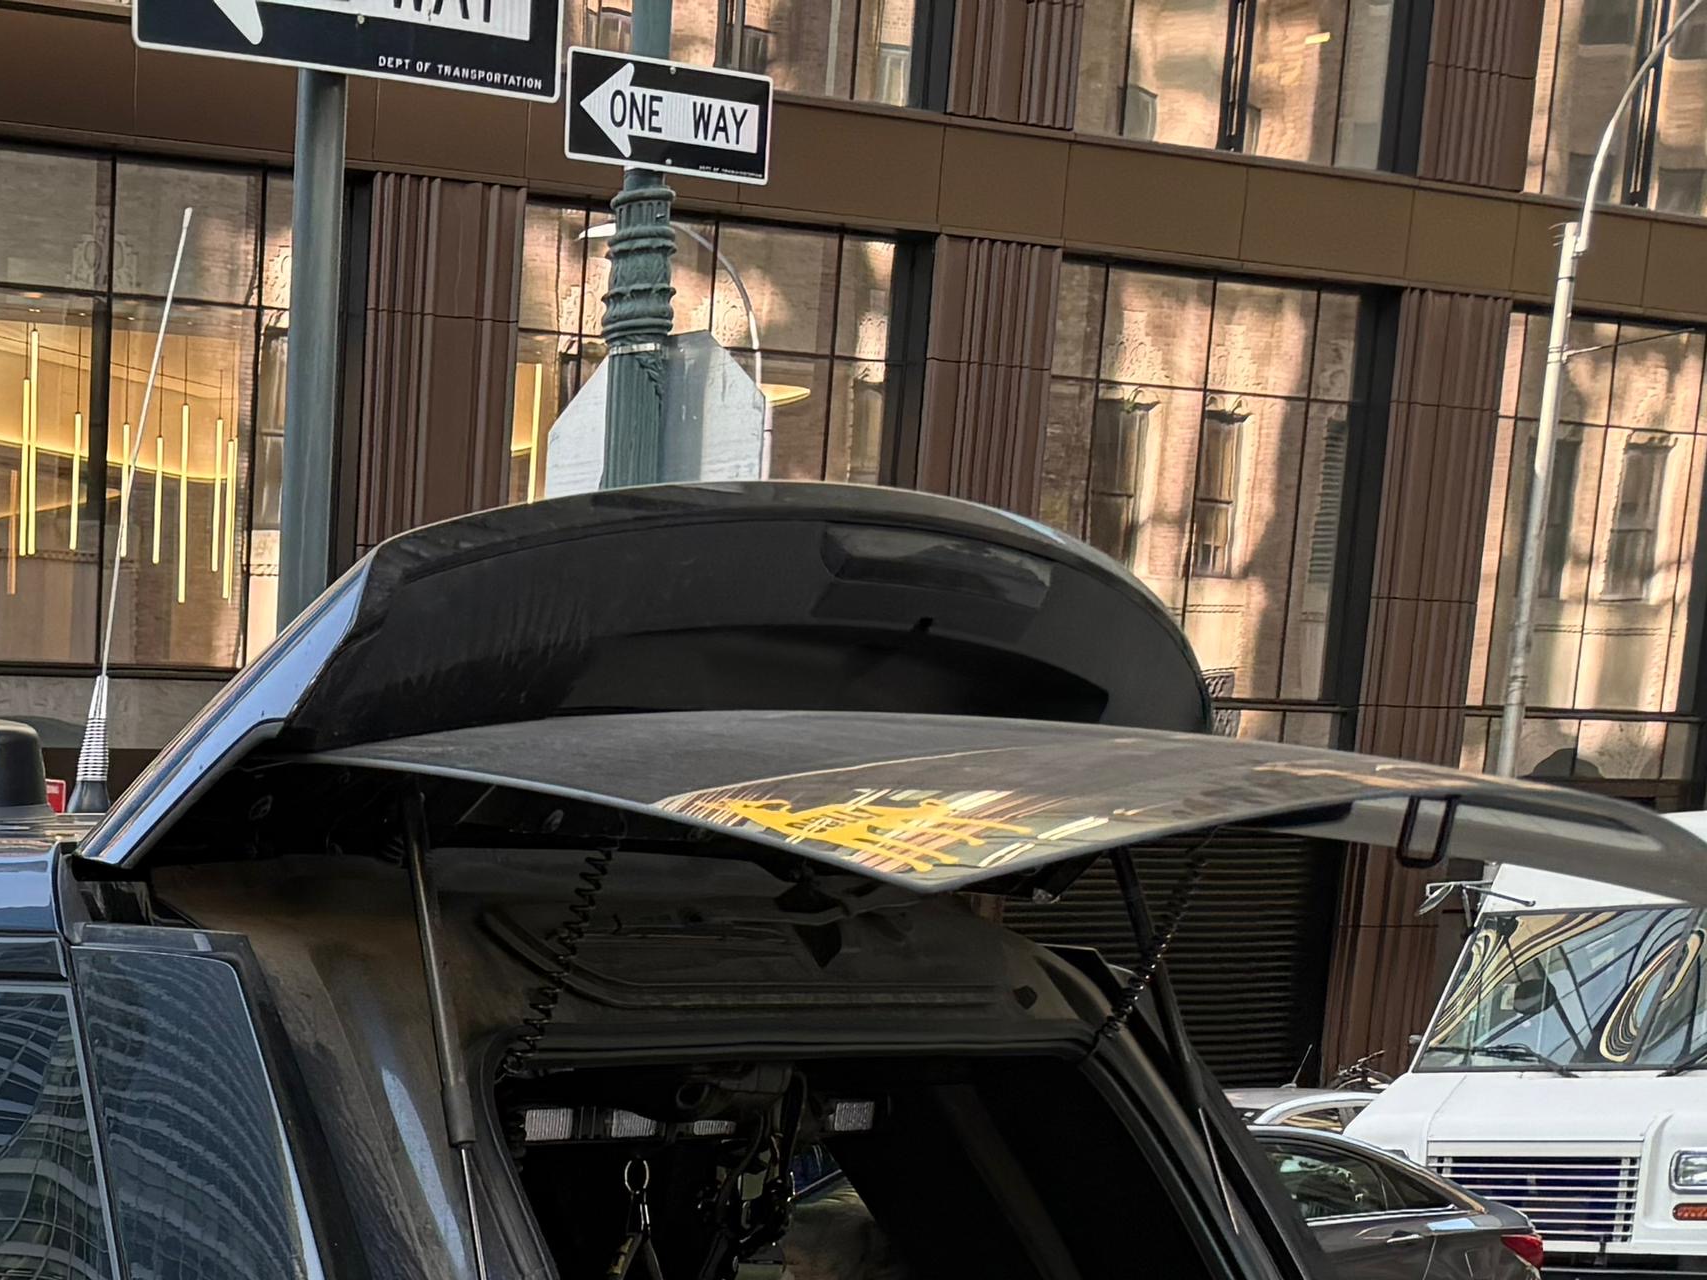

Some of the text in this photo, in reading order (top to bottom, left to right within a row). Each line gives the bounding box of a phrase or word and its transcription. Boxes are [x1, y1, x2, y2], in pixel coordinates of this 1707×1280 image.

[378, 55, 543, 91] DEPT OF TRANSPORTATION
[610, 89, 748, 146] ONE WAY
